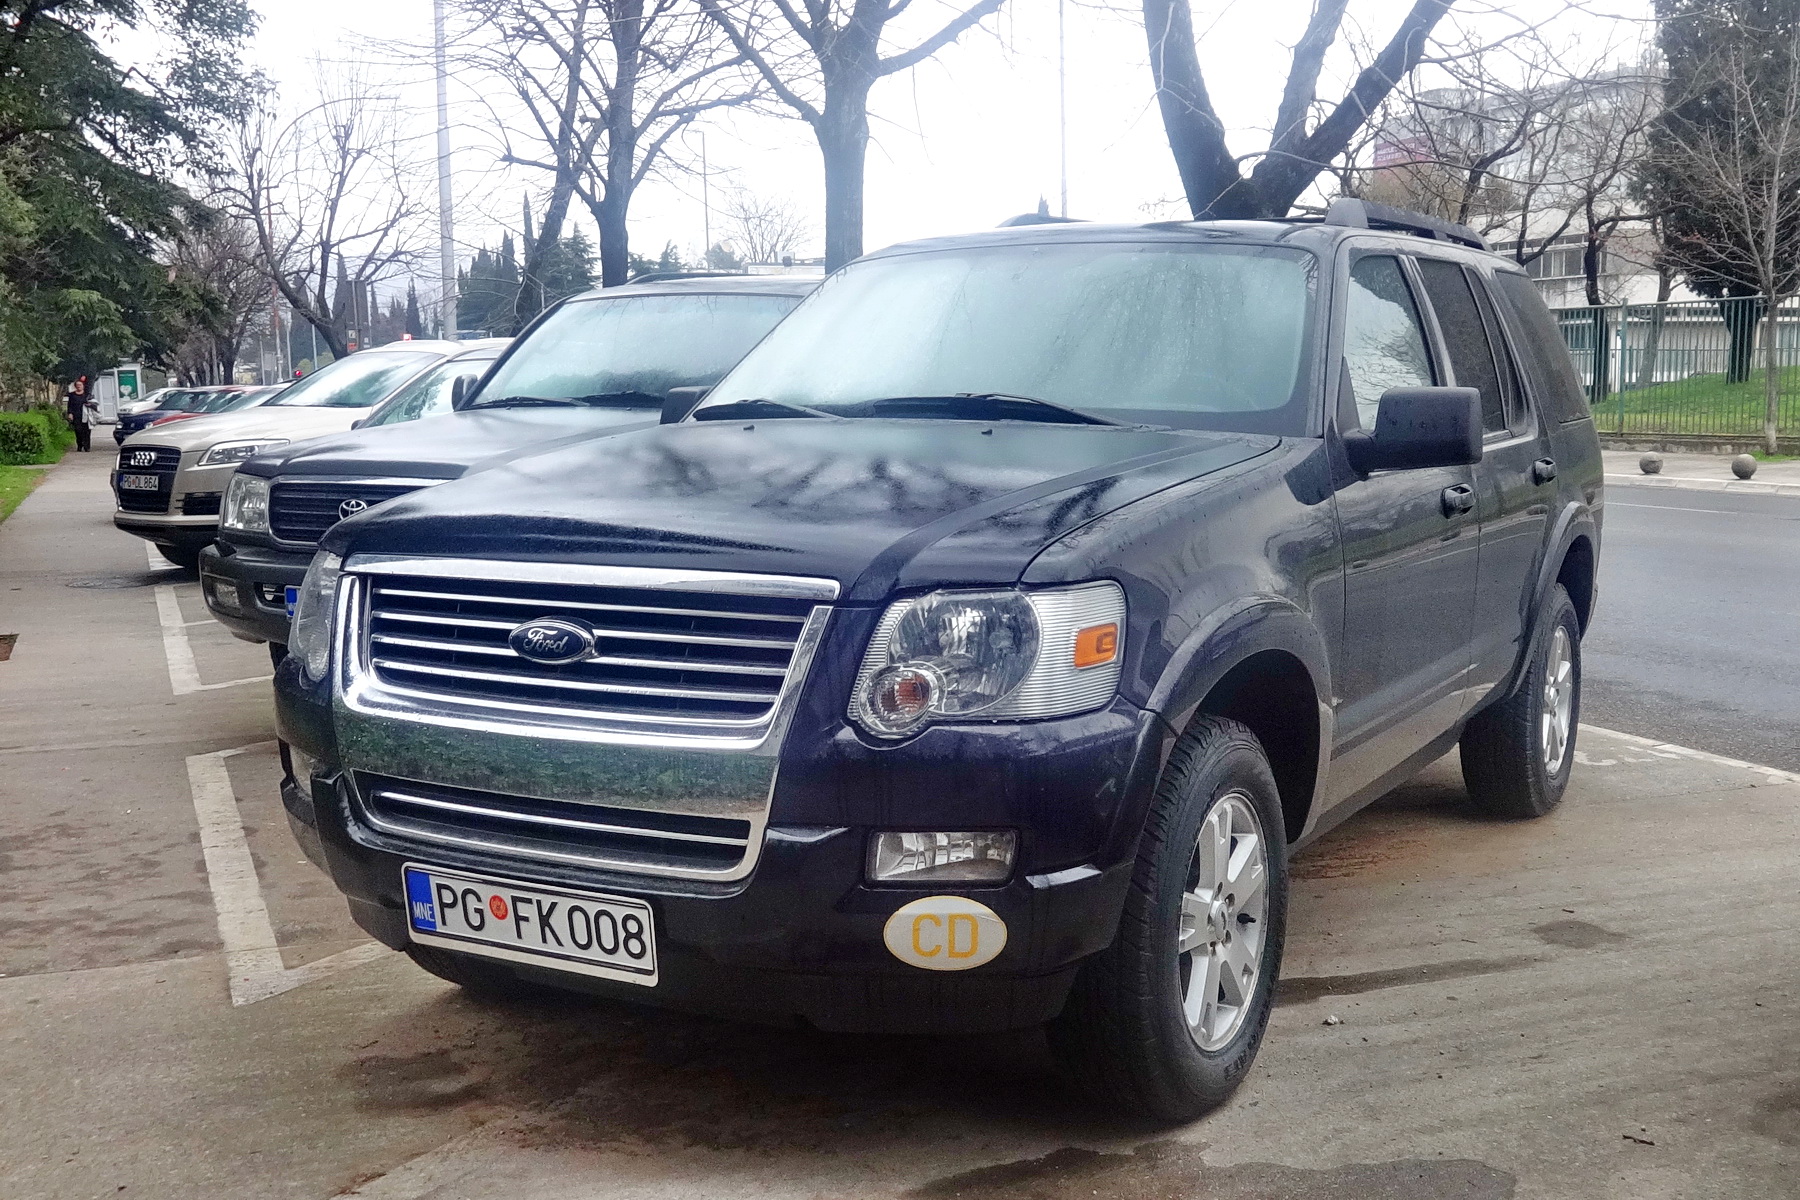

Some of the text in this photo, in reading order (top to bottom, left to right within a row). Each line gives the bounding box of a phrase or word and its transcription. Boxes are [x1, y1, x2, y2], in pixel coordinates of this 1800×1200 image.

[523, 627, 569, 654] Ford
[412, 900, 436, 922] MNE
[435, 882, 647, 960] PG FK008
[911, 912, 979, 958] CD
